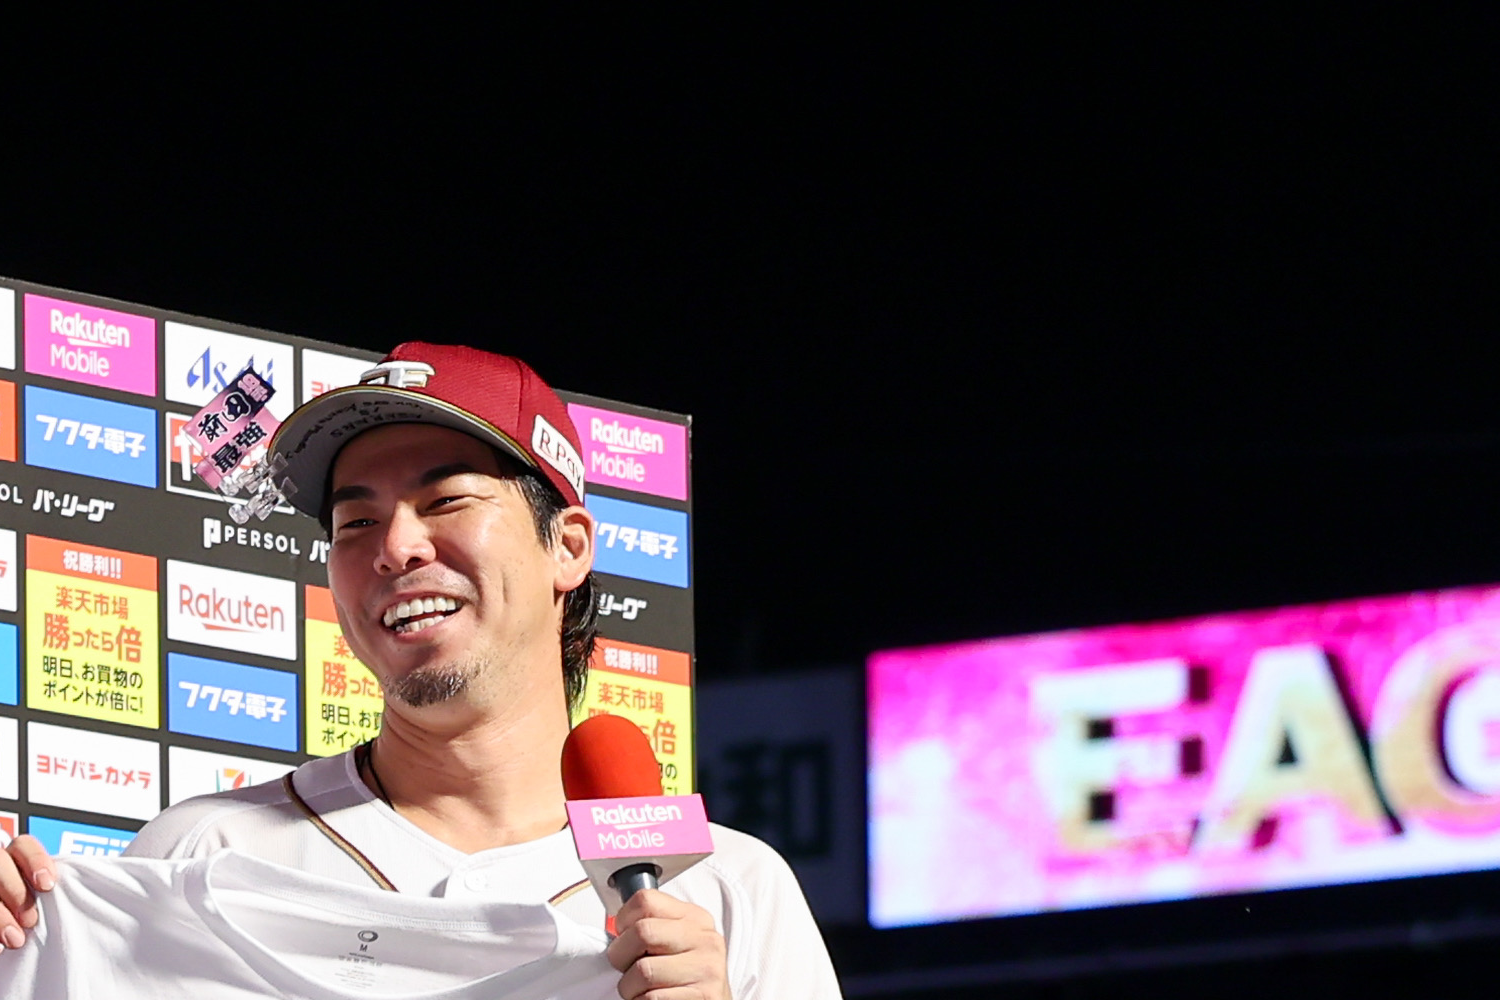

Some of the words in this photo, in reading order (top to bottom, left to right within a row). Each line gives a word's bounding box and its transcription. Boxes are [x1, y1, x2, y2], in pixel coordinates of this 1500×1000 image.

[52, 307, 131, 346] Rakuten
[50, 341, 110, 377] Mobile
[592, 418, 663, 454] Rakuten
[592, 452, 645, 482] Mobile
[224, 528, 300, 554] PERSOL
[54, 584, 129, 620] 楽天市場
[179, 581, 284, 633] Rakuten
[41, 609, 143, 664] 勝ったら倍
[41, 653, 144, 691] 明日、お買物の
[598, 682, 664, 714] 楽天市場
[38, 755, 151, 789] ヨドバシカメラ
[591, 804, 682, 825] Rakuten
[598, 829, 665, 850] Mobile
